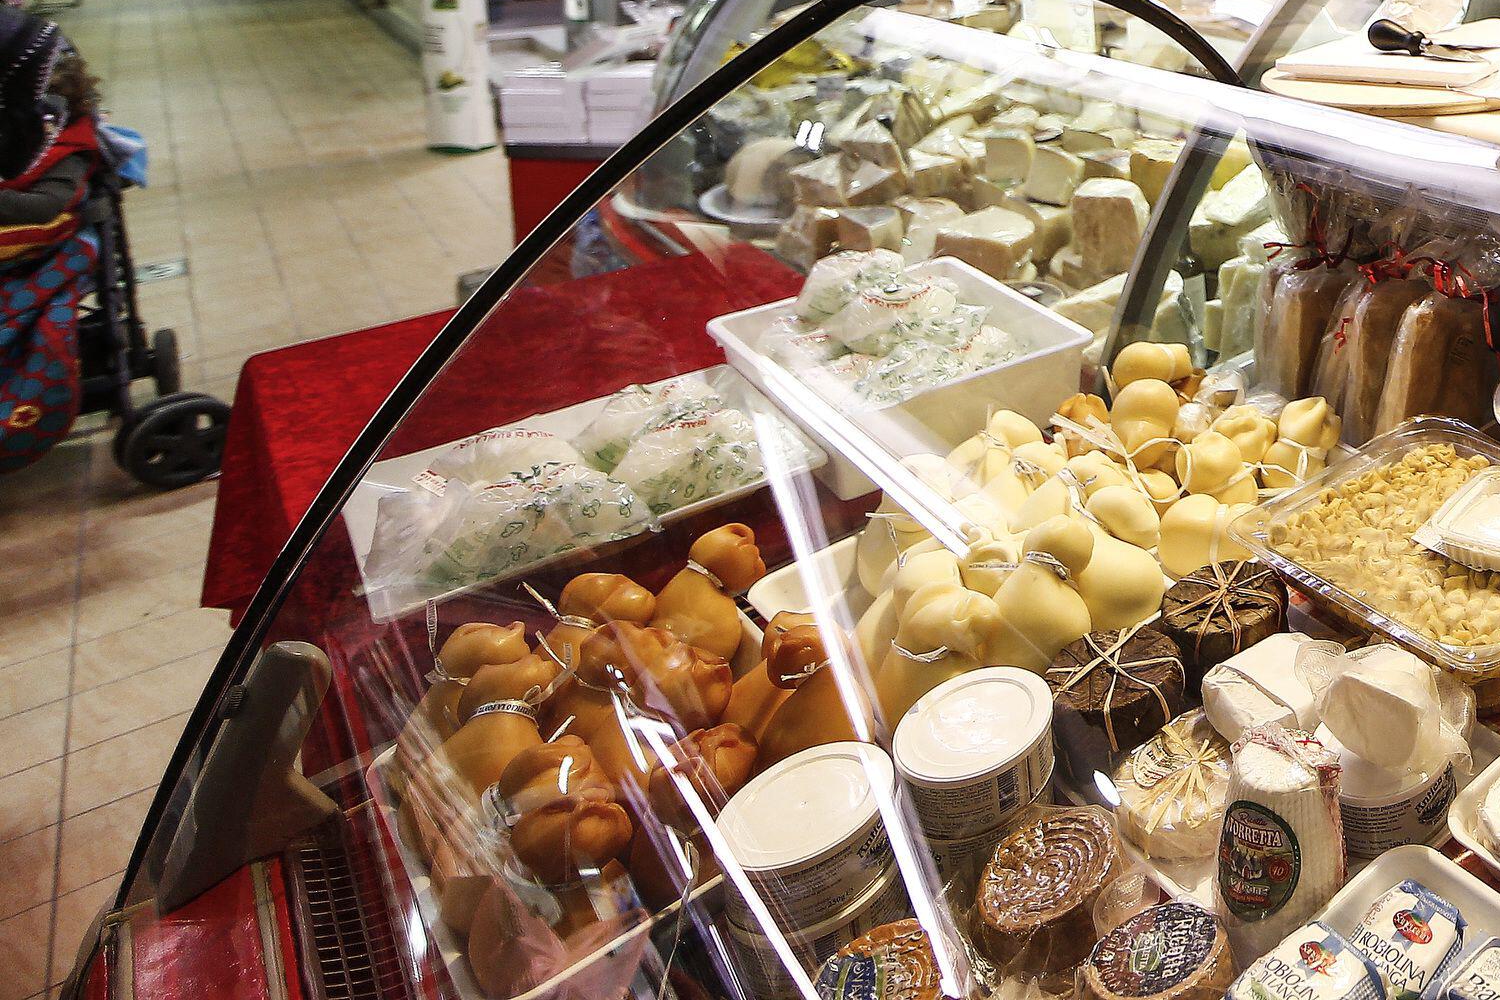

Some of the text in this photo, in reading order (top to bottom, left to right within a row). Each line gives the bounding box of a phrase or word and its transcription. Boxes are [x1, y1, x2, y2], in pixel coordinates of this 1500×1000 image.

[1228, 816, 1282, 848] TORRETTA
[1265, 956, 1321, 1000] OBIOLIN
[1358, 931, 1426, 989] ROBIOLINA
[884, 967, 897, 1000] TAVOL
